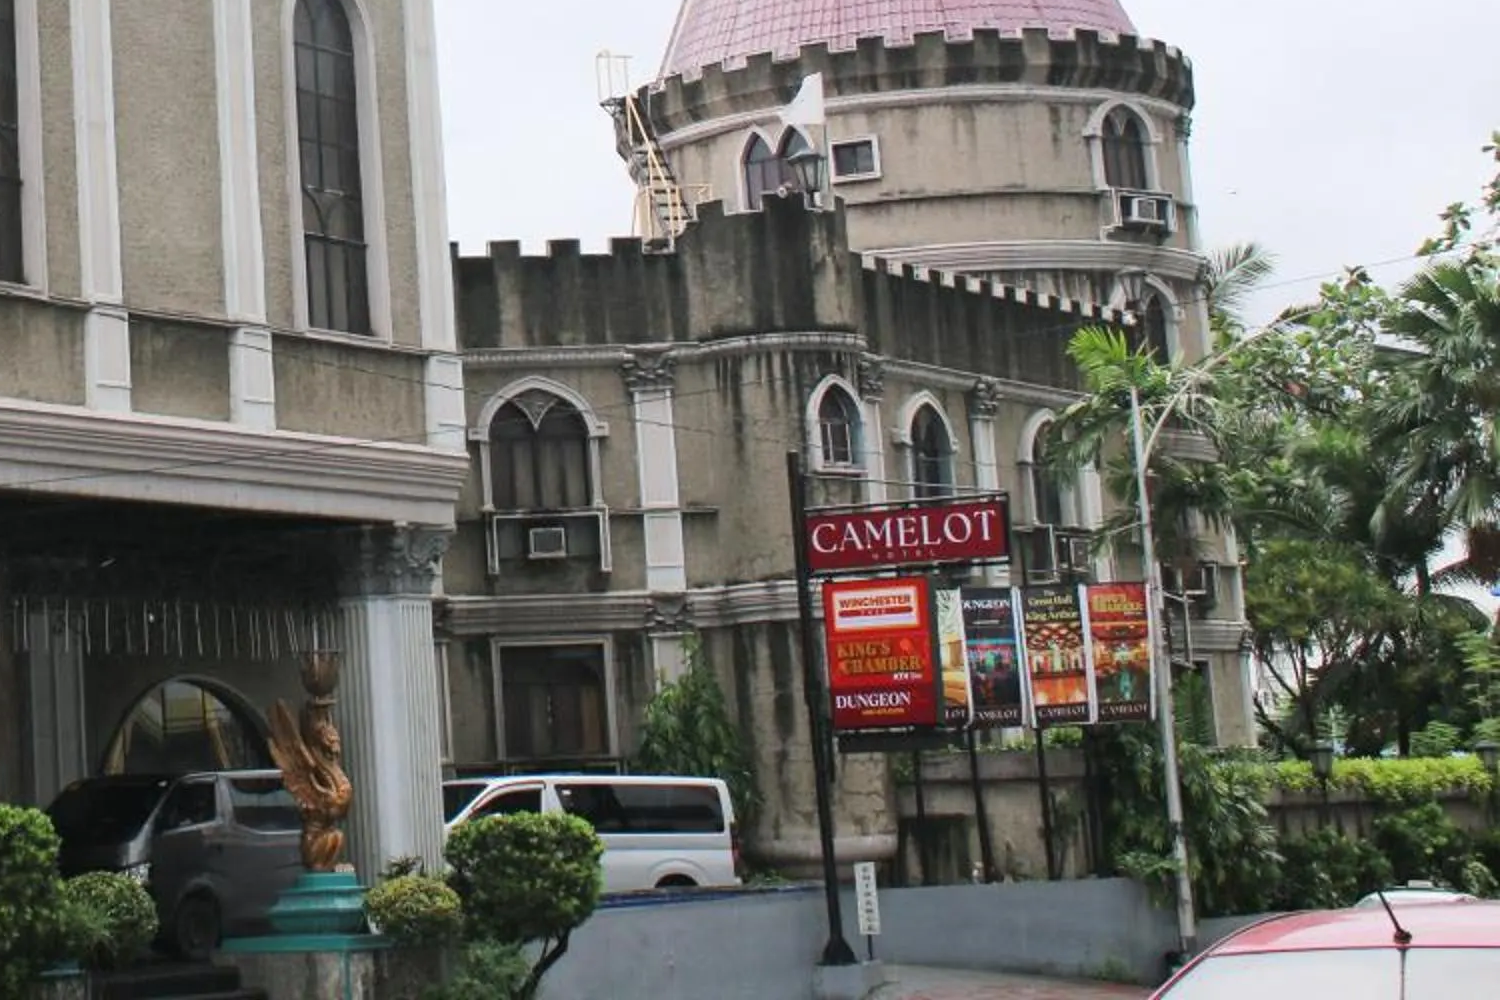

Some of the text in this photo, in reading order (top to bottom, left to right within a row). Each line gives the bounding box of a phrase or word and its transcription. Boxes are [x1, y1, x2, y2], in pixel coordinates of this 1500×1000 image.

[811, 509, 996, 553] CAMELOT
[872, 550, 936, 561] HOTEL
[836, 641, 891, 659] KING'S
[839, 655, 923, 675] CHAMBER
[836, 691, 911, 709] DUNGEON
